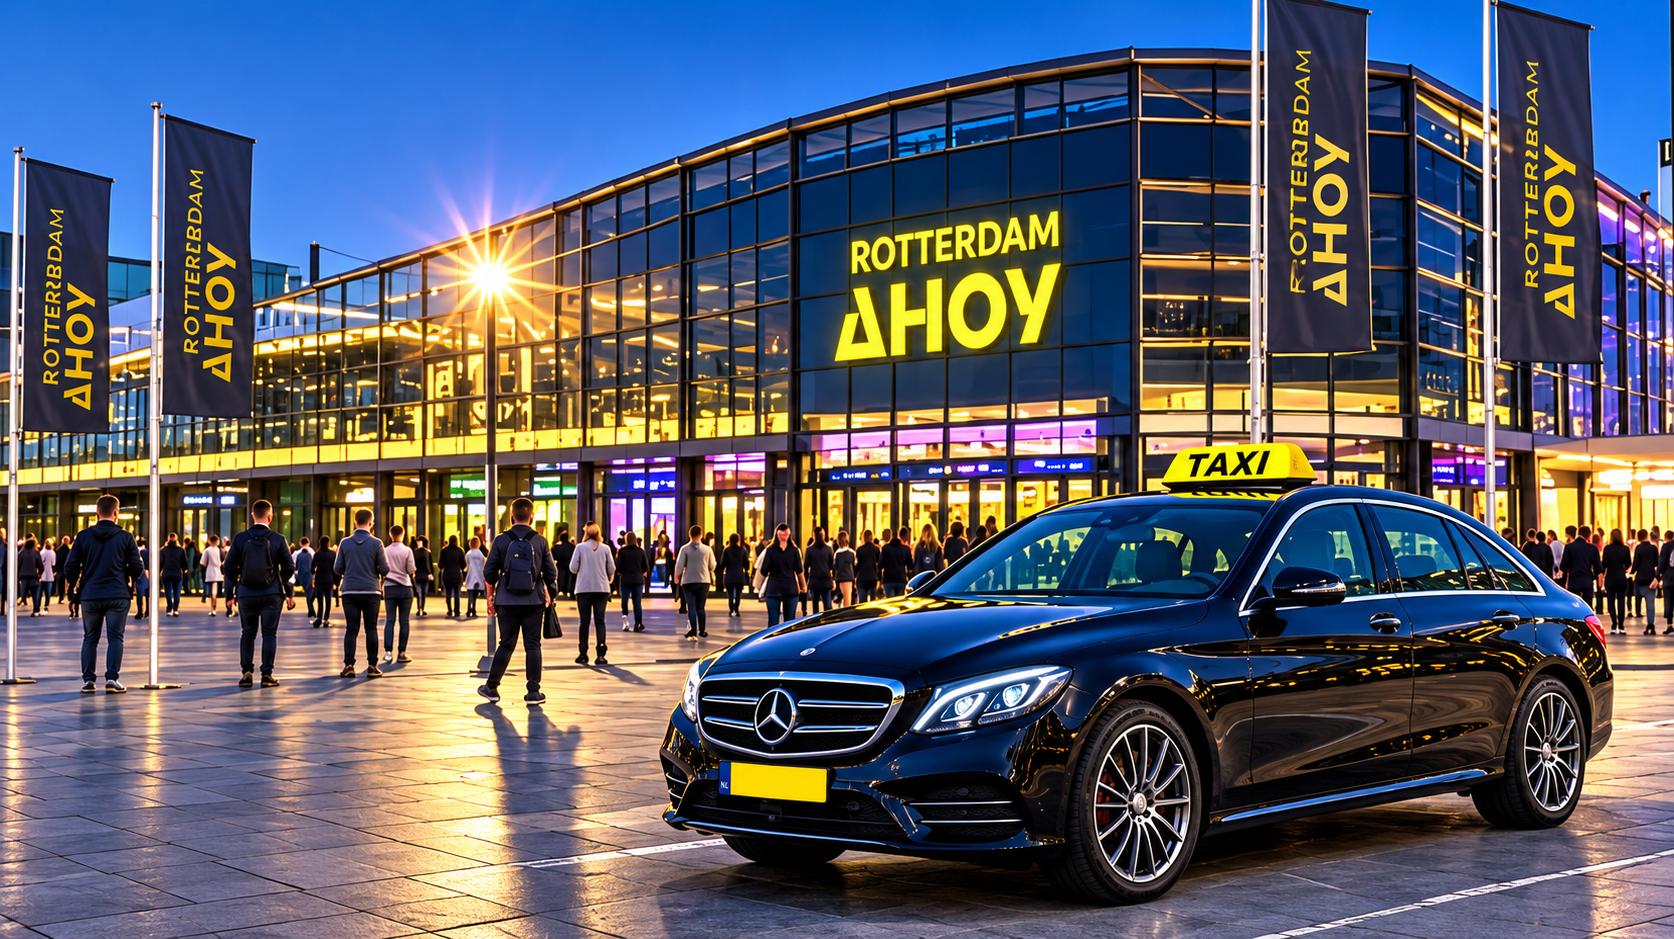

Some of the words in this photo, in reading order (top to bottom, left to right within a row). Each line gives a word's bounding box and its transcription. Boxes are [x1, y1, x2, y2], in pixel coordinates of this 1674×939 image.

[851, 210, 1060, 275] ROTTERDAM
[1312, 133, 1350, 307] AHOY
[1543, 144, 1577, 320] AHOY
[63, 282, 96, 411] AHOY
[202, 242, 237, 383] AHOY
[834, 262, 1062, 362] AHOY
[1189, 450, 1271, 478] TAXI
